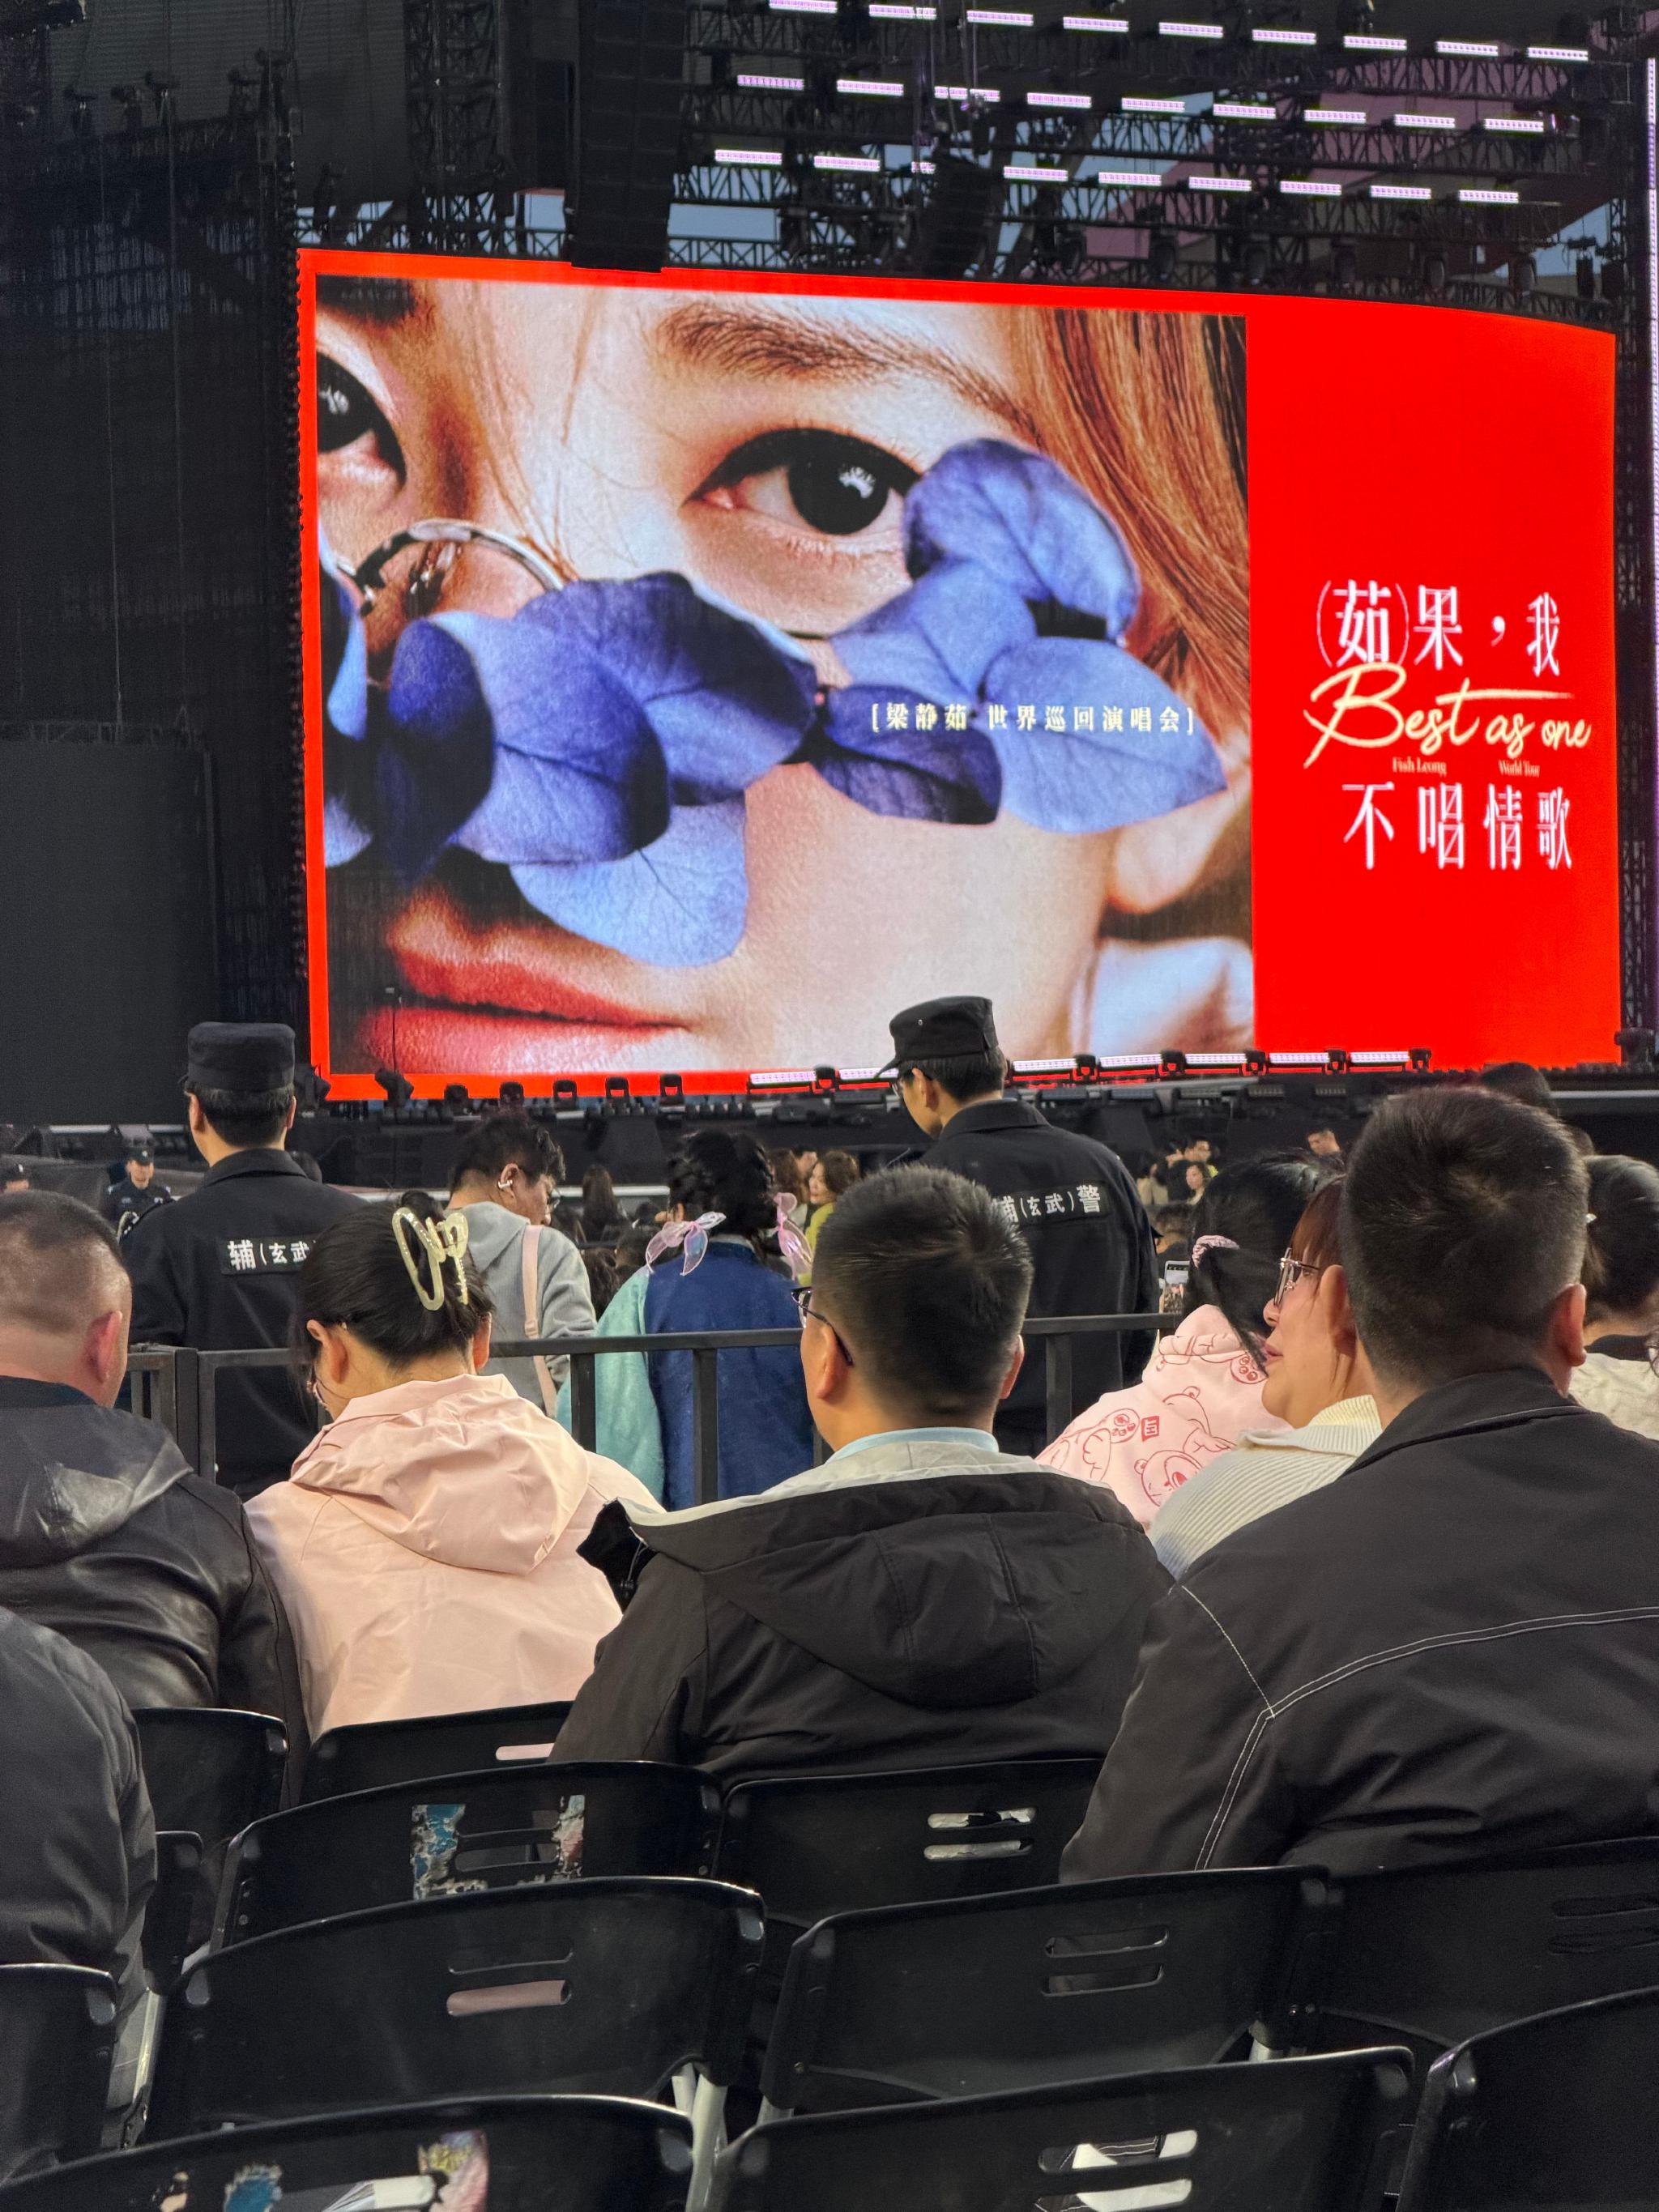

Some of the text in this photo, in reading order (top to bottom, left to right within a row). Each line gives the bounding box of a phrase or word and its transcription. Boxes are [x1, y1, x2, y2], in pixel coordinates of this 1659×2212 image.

[1303, 661, 1592, 769] Best as one
[1392, 756, 1415, 773] Fish
[1341, 781, 1572, 870] 不唱情歌
[227, 1238, 316, 1271] 辅(玄武
